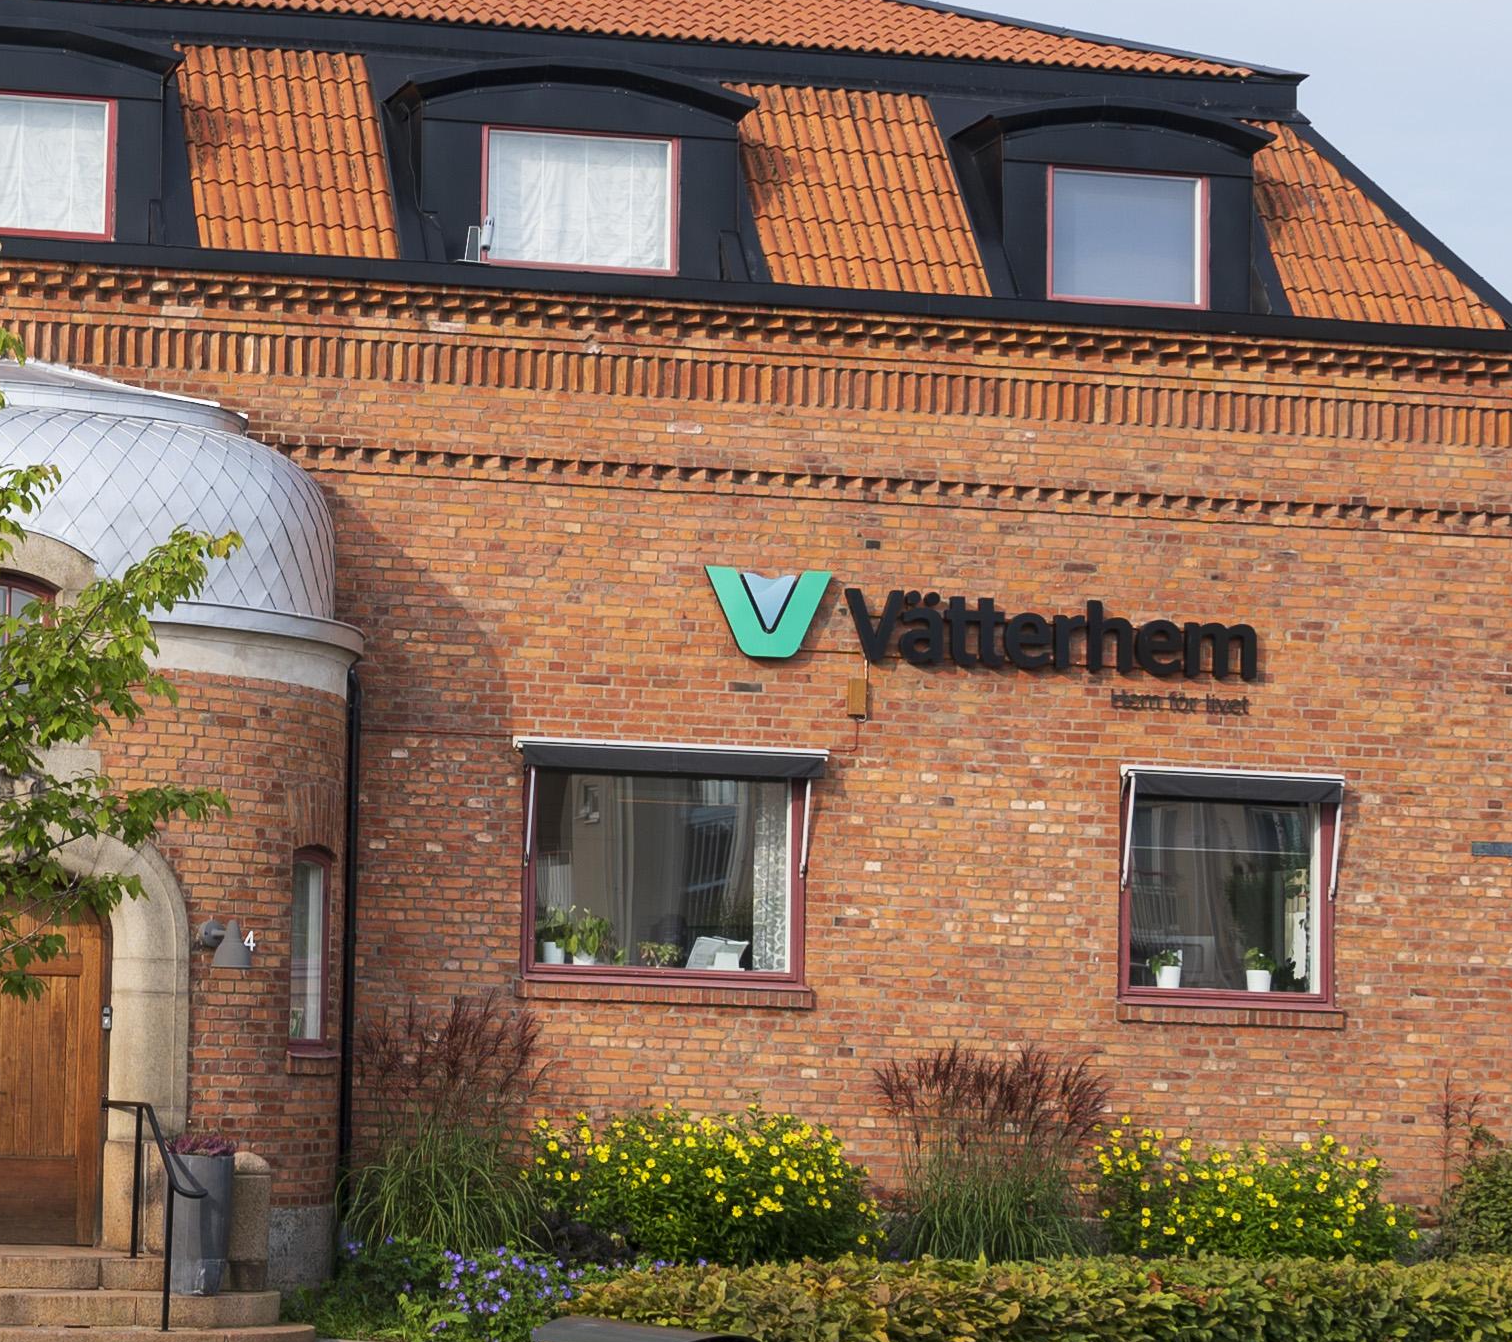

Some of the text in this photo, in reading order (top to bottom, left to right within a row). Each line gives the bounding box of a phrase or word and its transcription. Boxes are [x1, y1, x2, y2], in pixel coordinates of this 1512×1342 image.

[845, 588, 1257, 680] Vätterhem
[1111, 688, 1250, 715] Hem för livet
[243, 930, 256, 951] 4
